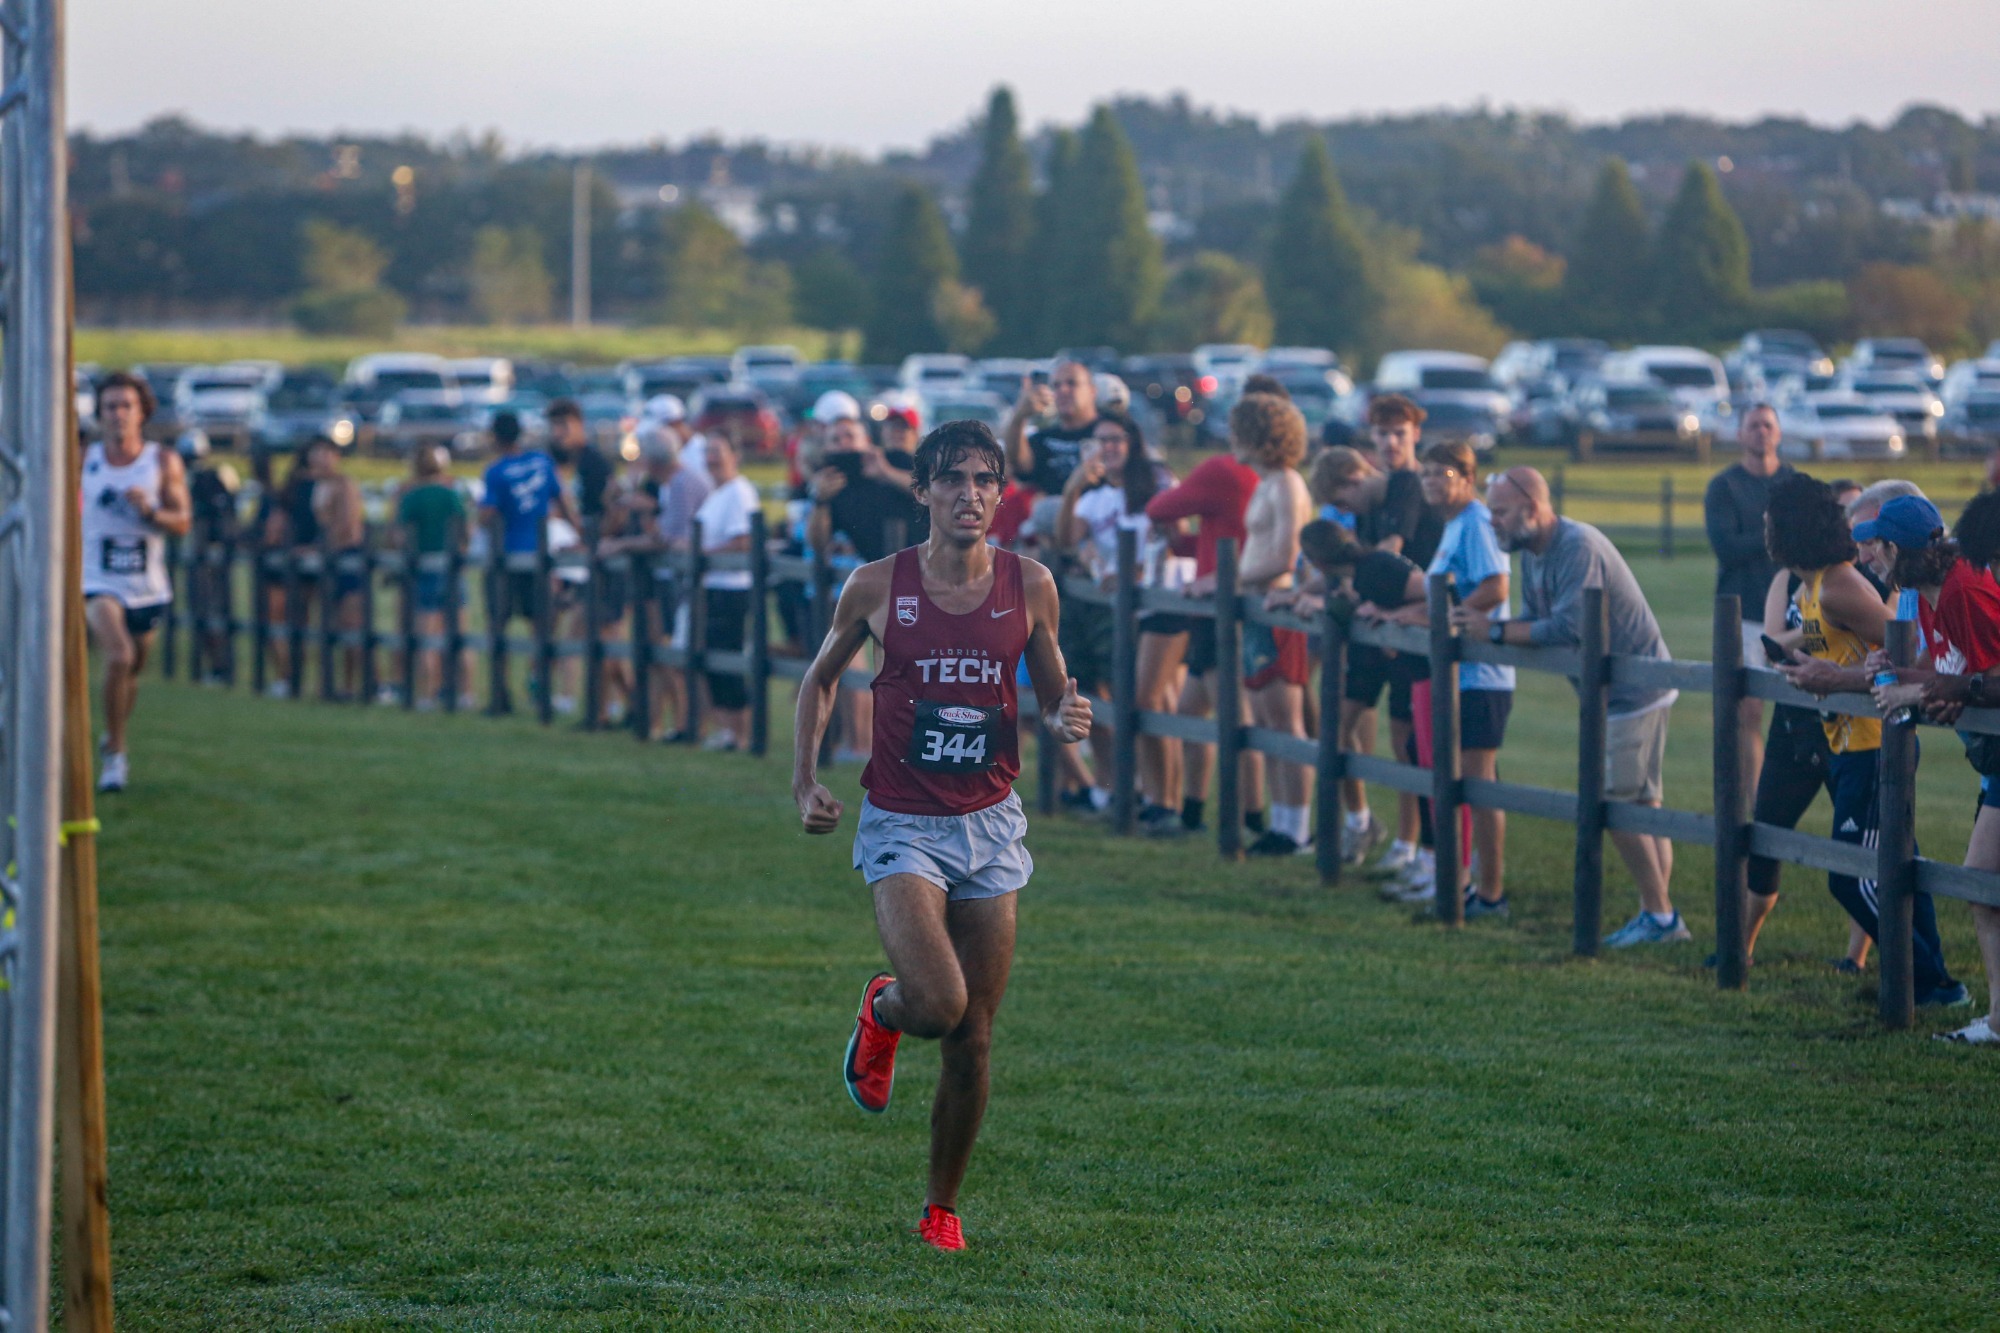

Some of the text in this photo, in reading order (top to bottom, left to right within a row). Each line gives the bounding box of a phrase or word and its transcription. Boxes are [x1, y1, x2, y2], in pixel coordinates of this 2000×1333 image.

[915, 658, 1002, 684] TECH
[938, 708, 960, 718] Track
[961, 711, 986, 720] Shack
[922, 730, 986, 763] 344
